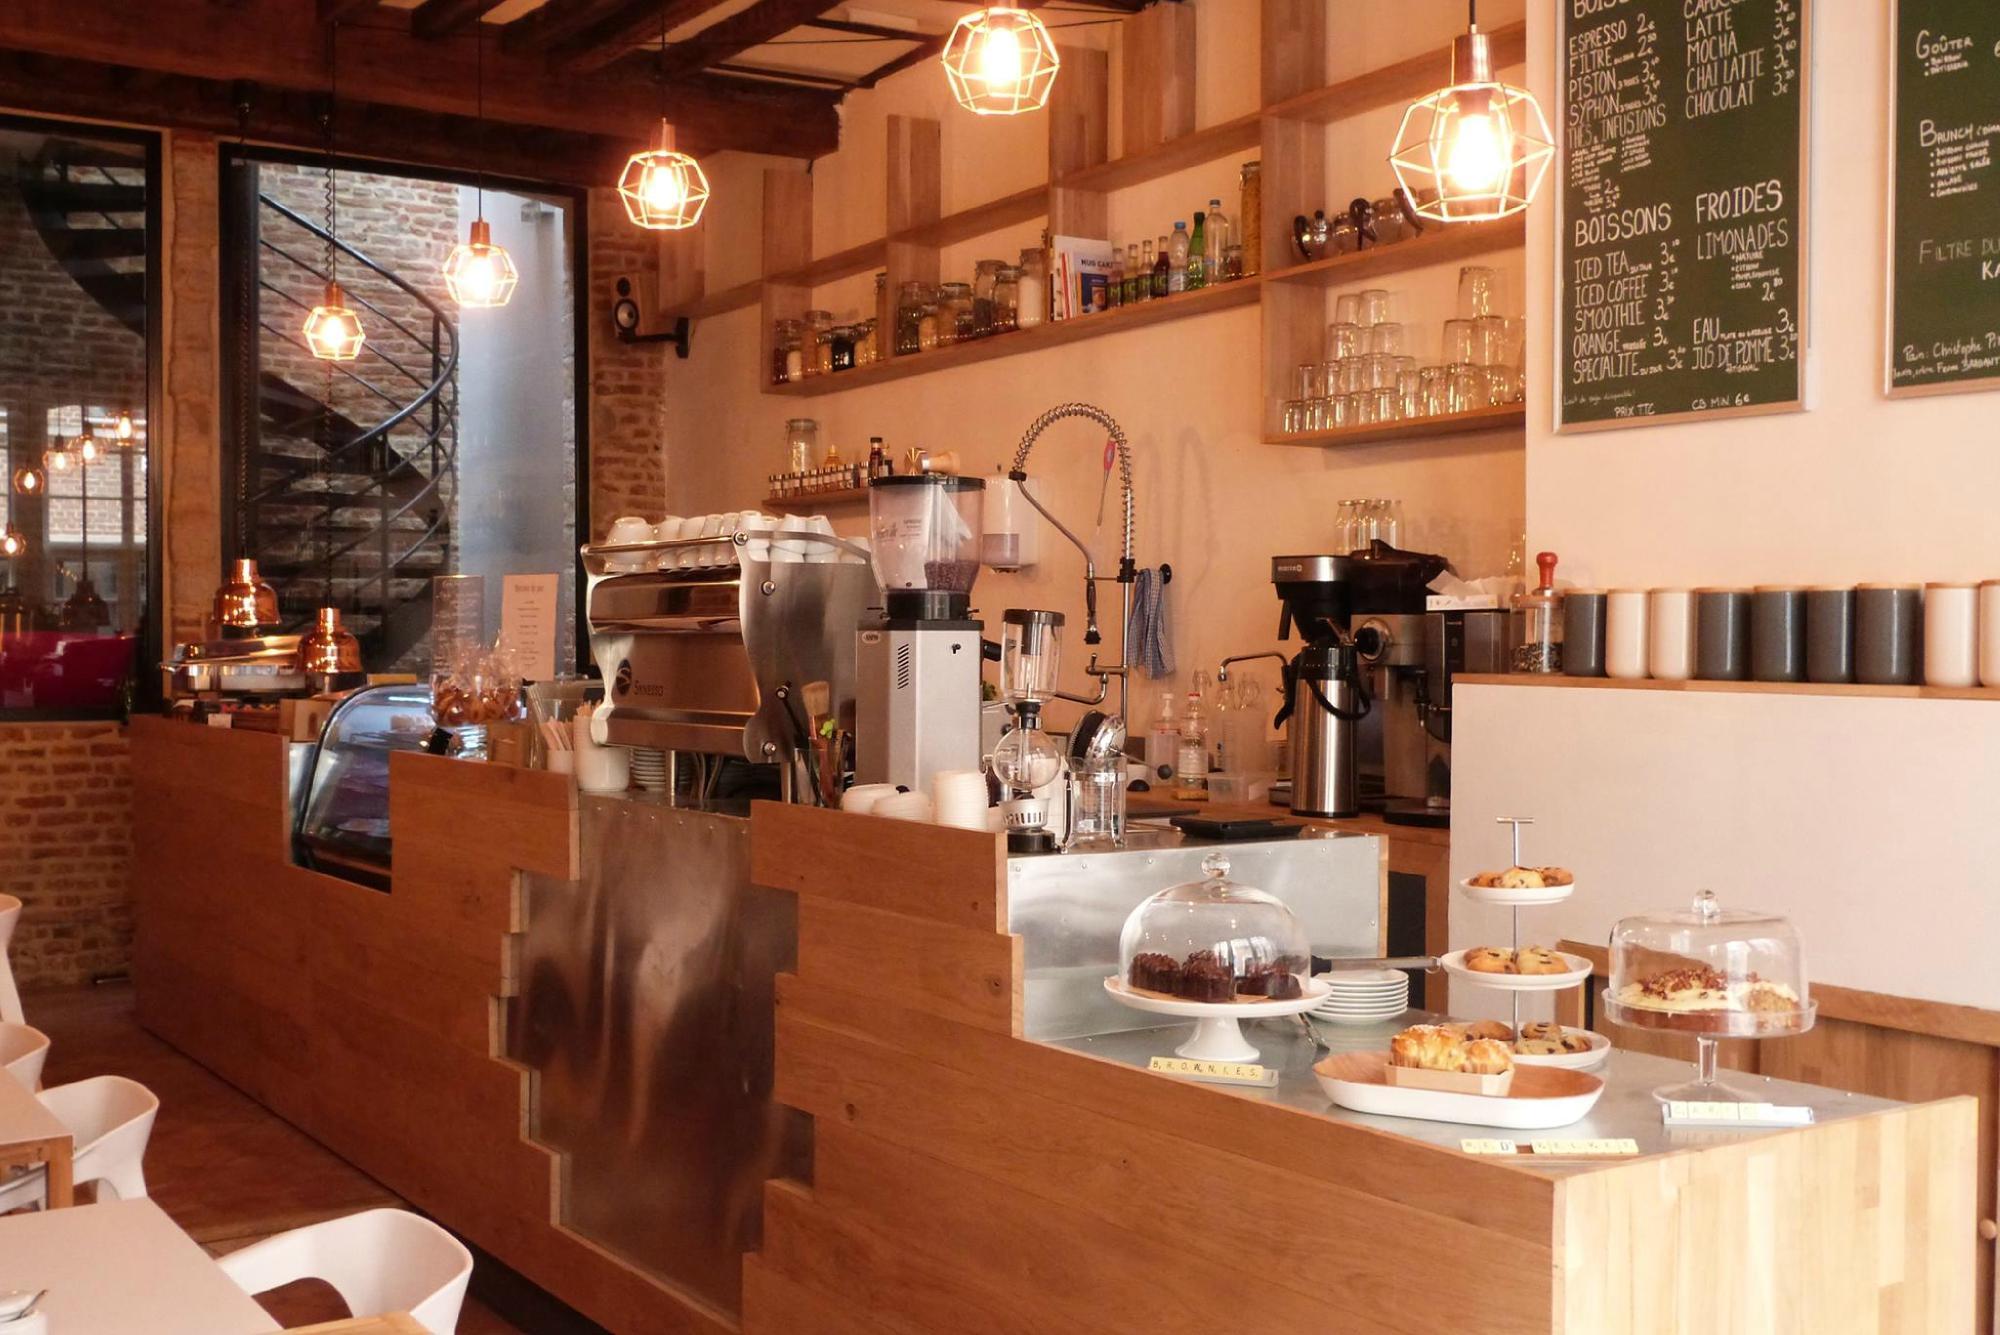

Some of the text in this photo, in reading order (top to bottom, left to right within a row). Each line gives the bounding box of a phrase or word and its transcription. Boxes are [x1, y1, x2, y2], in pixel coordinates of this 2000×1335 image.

[1569, 20, 1627, 56] ESPRESSO
[1686, 8, 1734, 42] LATTE
[1569, 46, 1613, 77] FILTRE
[1687, 31, 1738, 67] MOCHA
[1686, 62, 1718, 93] CHAI
[1723, 48, 1765, 84] LATTE
[1569, 92, 1620, 127] SYPHON
[1686, 80, 1755, 119] CHOCOLAT
[1601, 103, 1667, 142] INFUSIONS
[1575, 179, 1784, 247] BOISSONS FROIDES
[1697, 217, 1789, 260] LIMONADES
[1919, 239, 1972, 265] FILTRE
[1575, 256, 1602, 283] ICED
[1606, 250, 1630, 276] TEA
[1575, 283, 1605, 308] ICED
[1607, 274, 1649, 303] COFFEE
[1574, 300, 1645, 332] SMOOTHIE
[1693, 317, 1720, 345] EAU
[1573, 329, 1621, 359] ORANGE
[1691, 344, 1714, 370] JUS
[1717, 343, 1733, 368] DE
[1735, 336, 1776, 364] POMME
